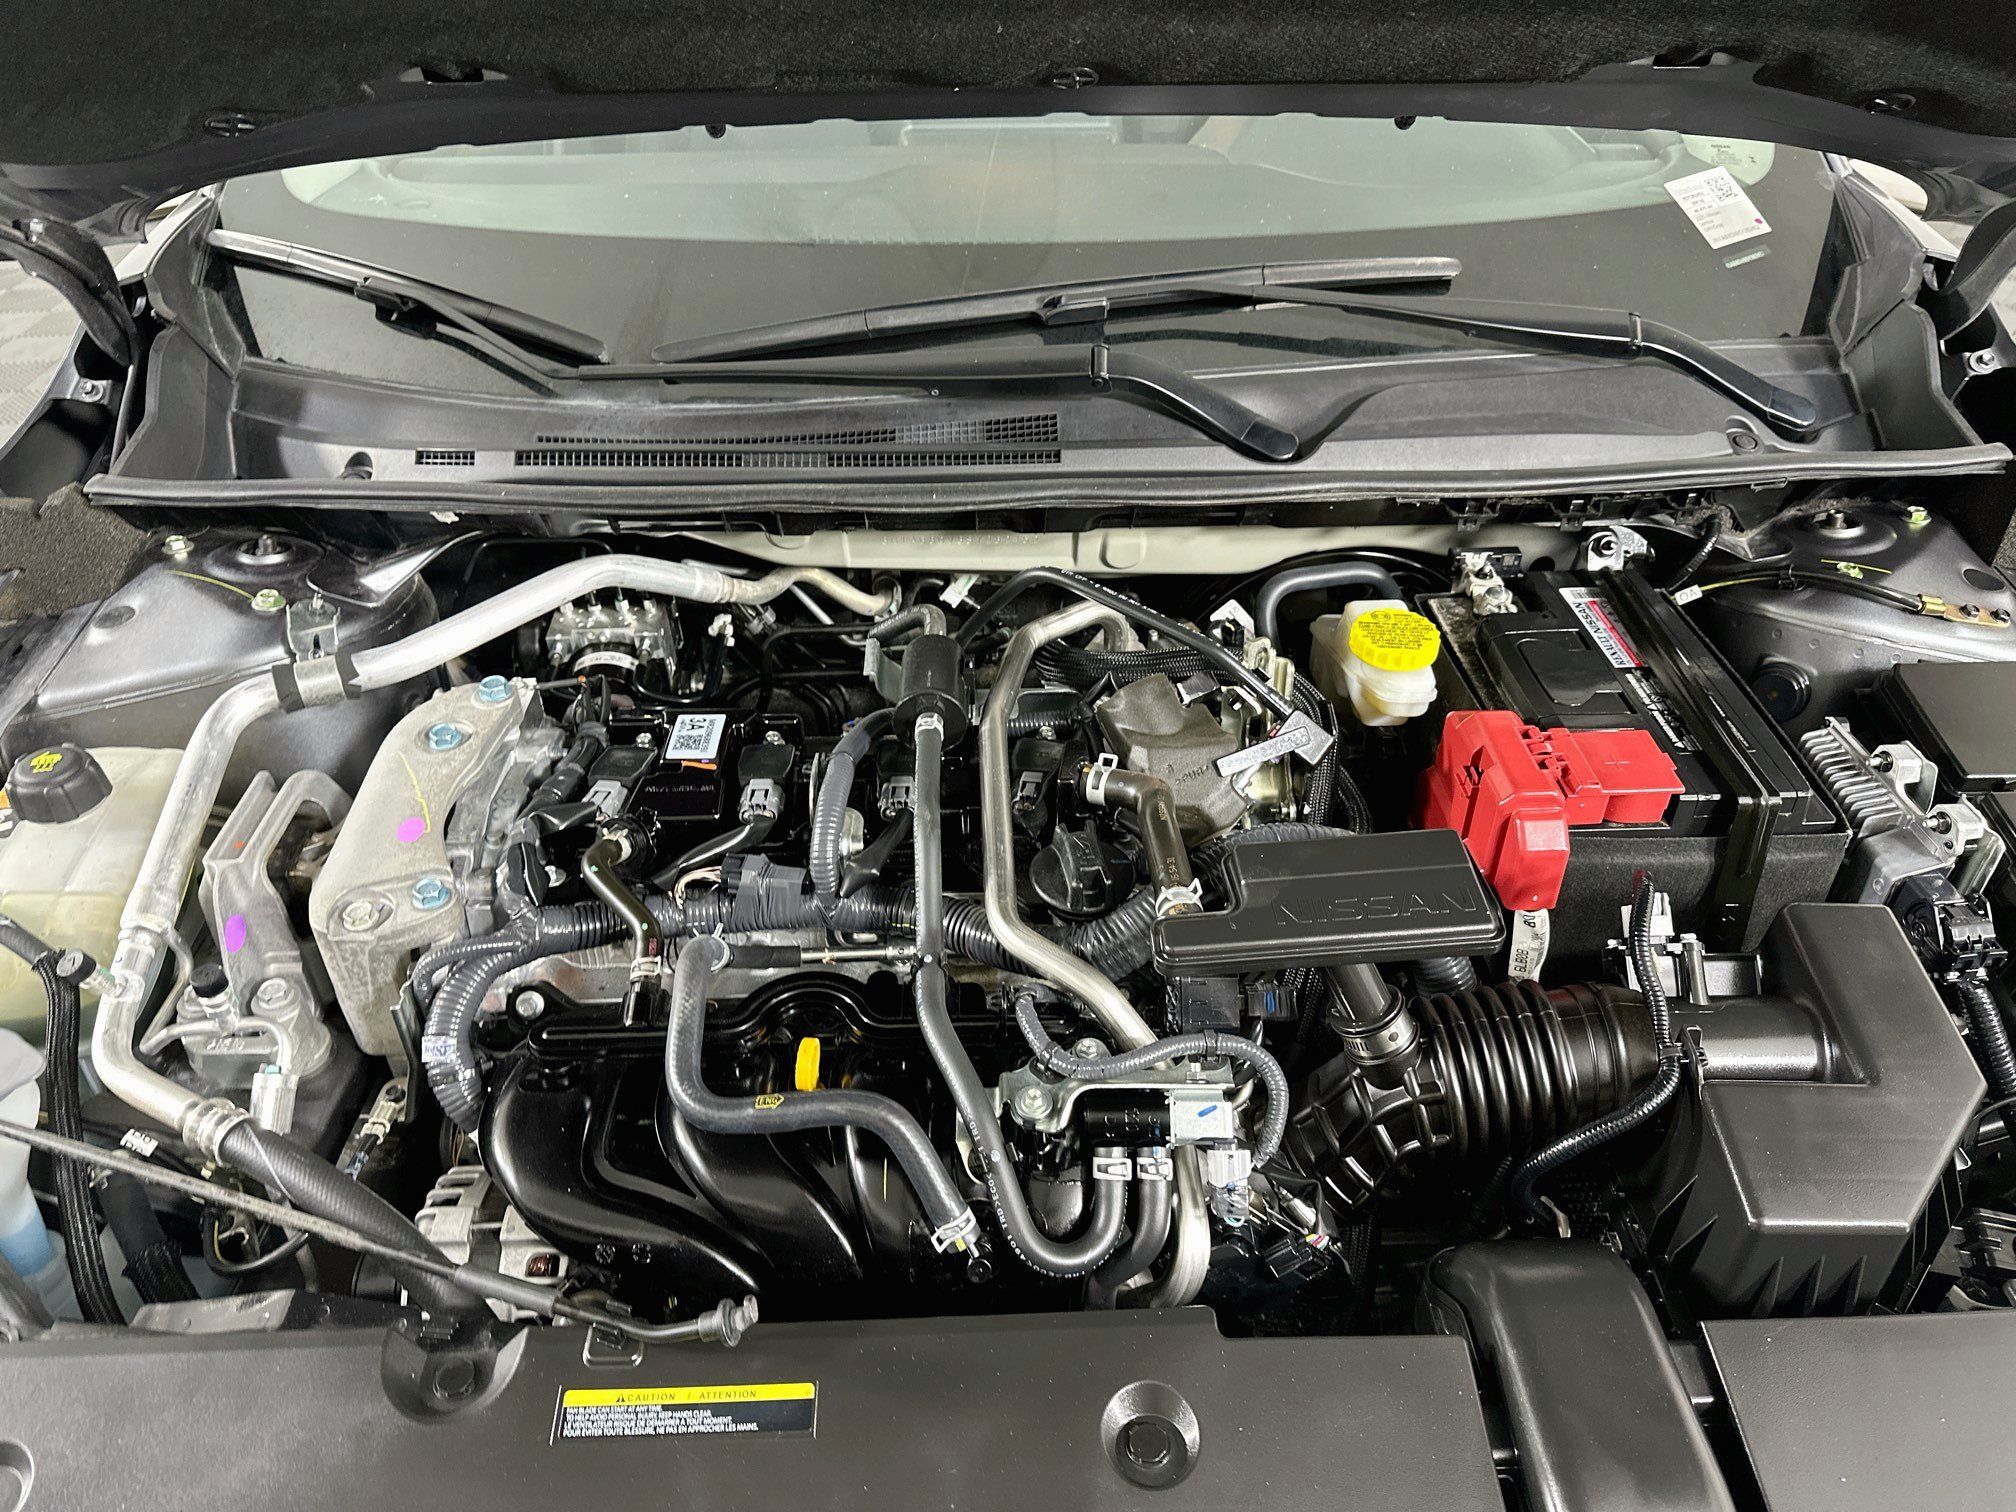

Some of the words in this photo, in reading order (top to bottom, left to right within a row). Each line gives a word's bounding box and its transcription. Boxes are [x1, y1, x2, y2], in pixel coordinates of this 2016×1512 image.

[1573, 602, 1602, 634] NISSAN
[686, 717, 707, 731] 3A
[1271, 888, 1476, 925] NISSAN
[627, 1393, 676, 1402] CAUTION
[699, 1390, 757, 1399] ATTENTION
